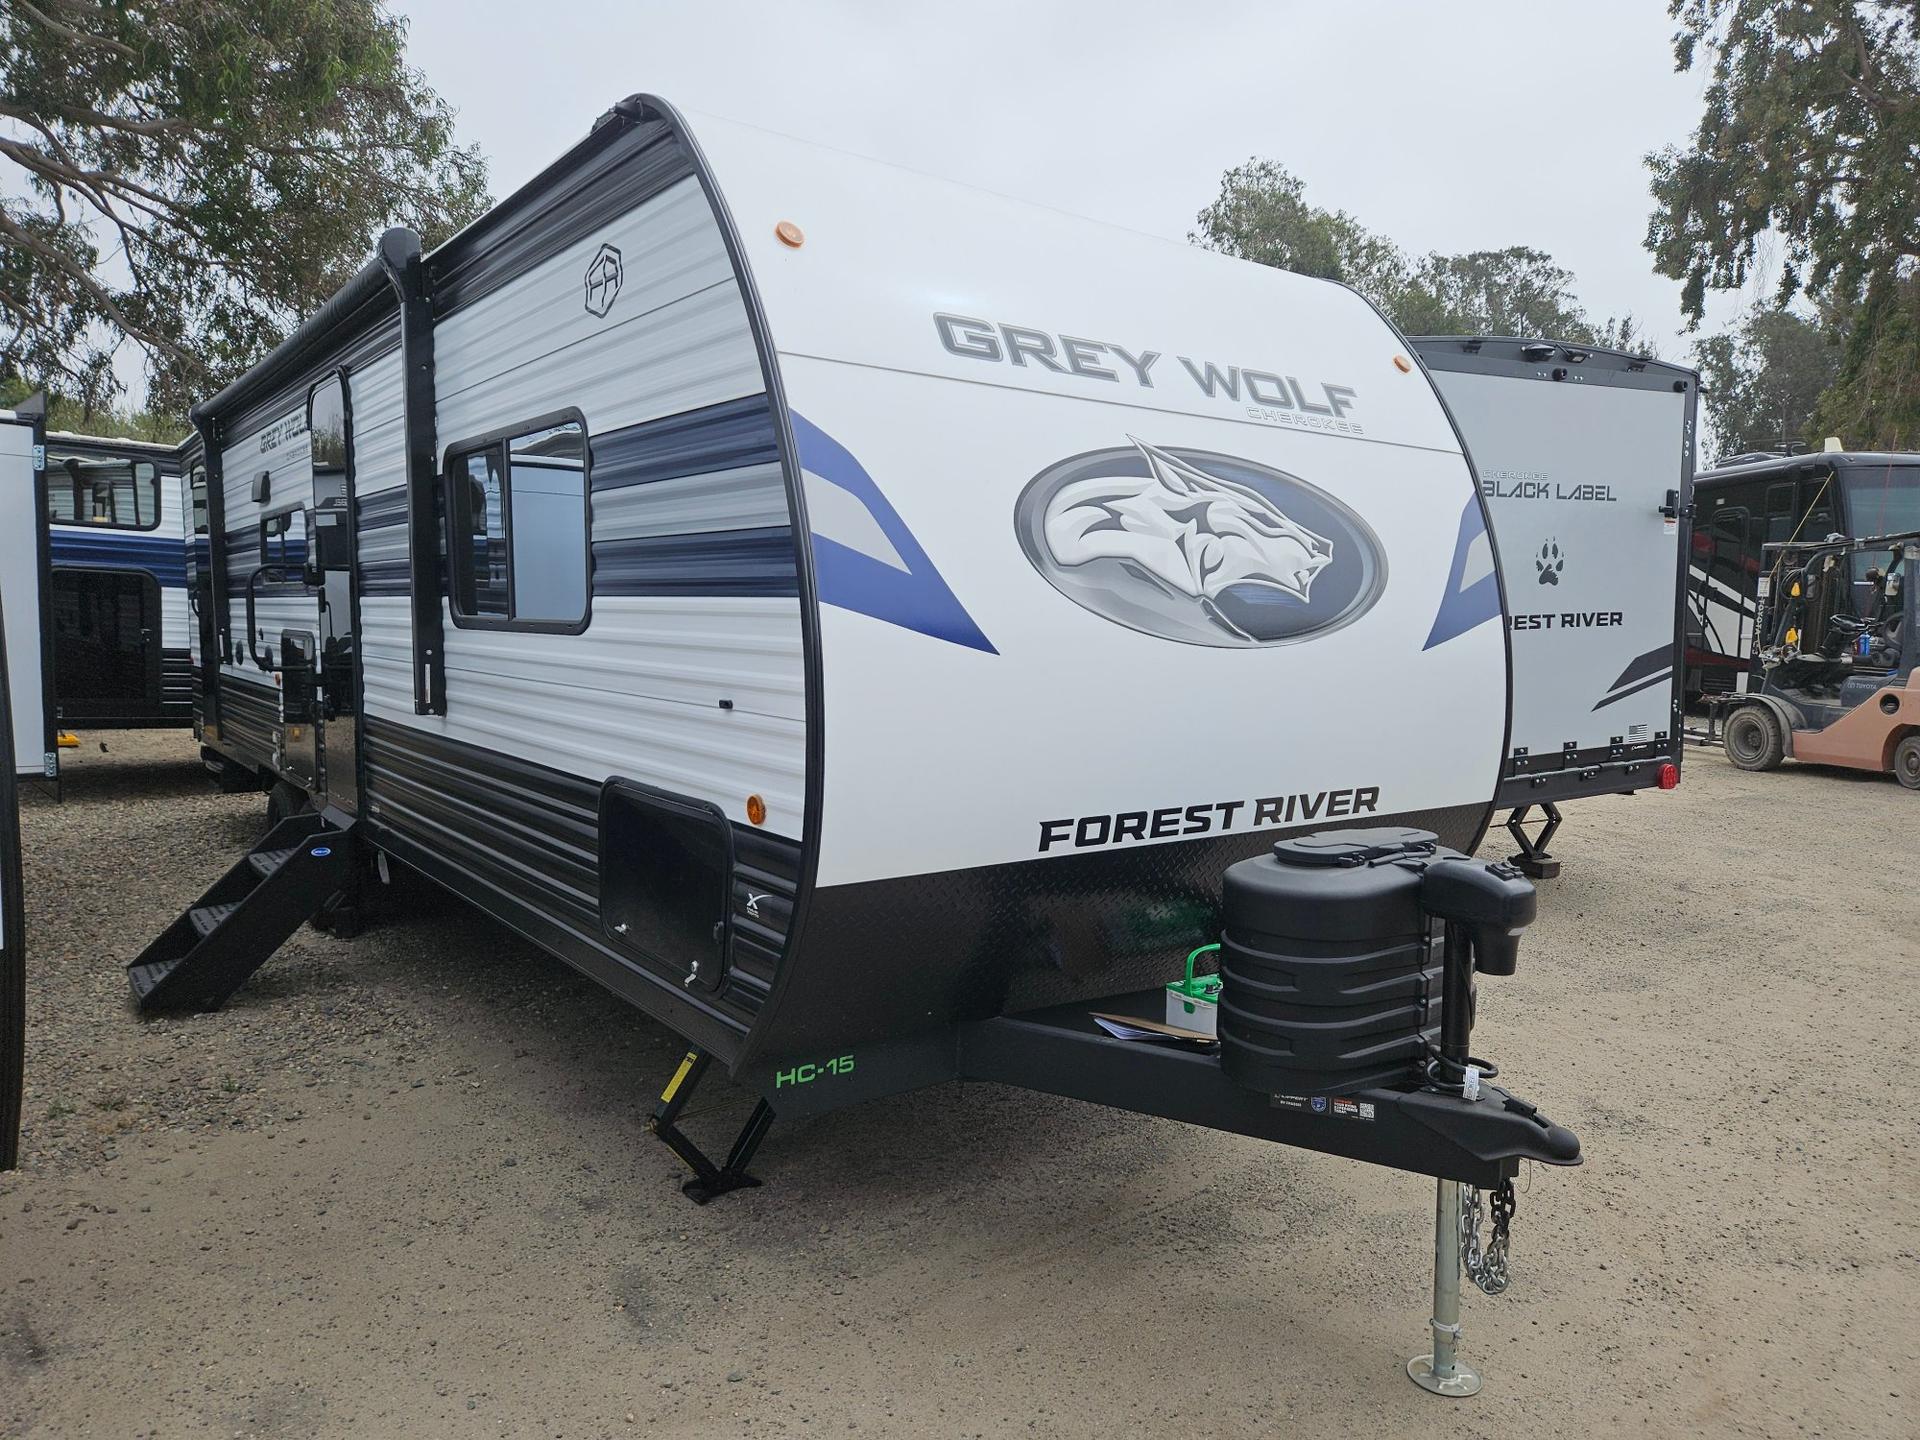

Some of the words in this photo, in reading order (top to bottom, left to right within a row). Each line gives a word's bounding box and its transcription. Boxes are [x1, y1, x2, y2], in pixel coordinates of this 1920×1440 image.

[933, 311, 1162, 388] GREY
[1176, 356, 1360, 418] WOLF
[260, 424, 283, 454] GREY
[284, 413, 307, 441] WOL
[1246, 406, 1364, 434] CHEROKEE
[1482, 480, 1550, 499] BLACK
[1556, 483, 1617, 501] LABEL
[1560, 612, 1623, 628] RIVER
[1755, 597, 1766, 635] TOYOTA
[1038, 800, 1245, 852] FOREST
[1253, 786, 1380, 826] RIVER
[776, 1055, 854, 1088] HC-15
